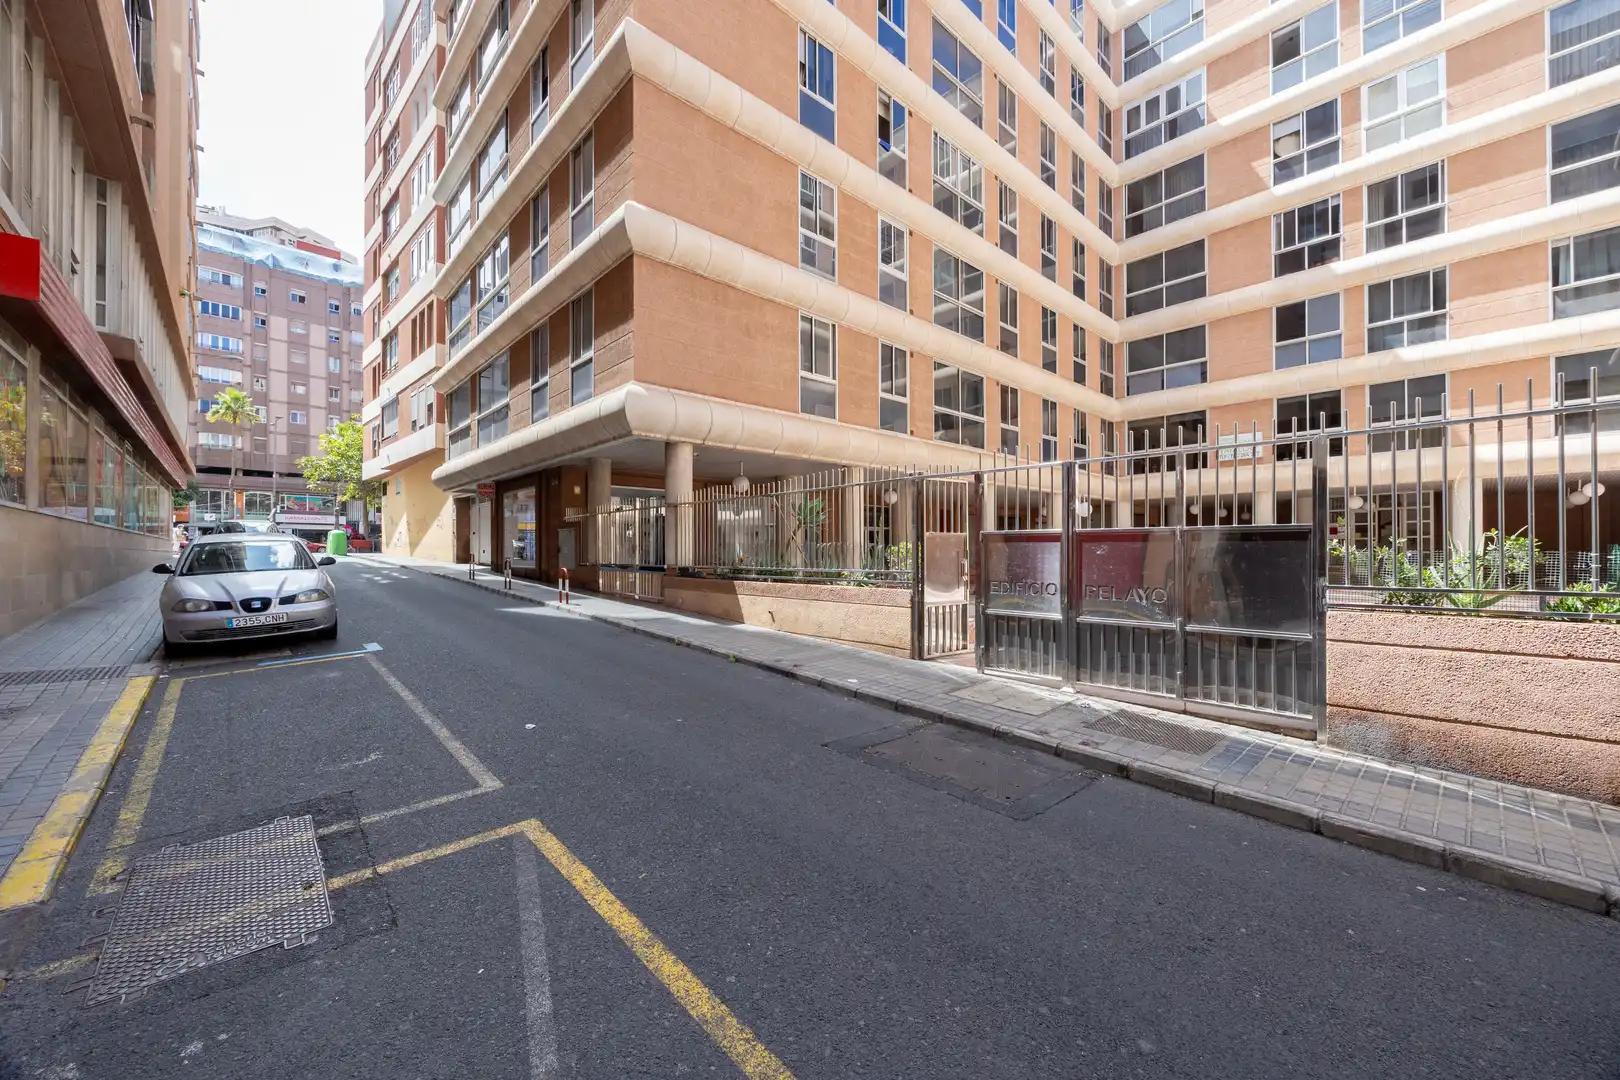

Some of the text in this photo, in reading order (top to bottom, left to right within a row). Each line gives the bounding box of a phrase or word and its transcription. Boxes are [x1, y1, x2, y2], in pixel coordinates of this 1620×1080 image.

[988, 581, 1167, 605] EDIFICIO PELAYO
[234, 614, 285, 627] 2355 CNH
